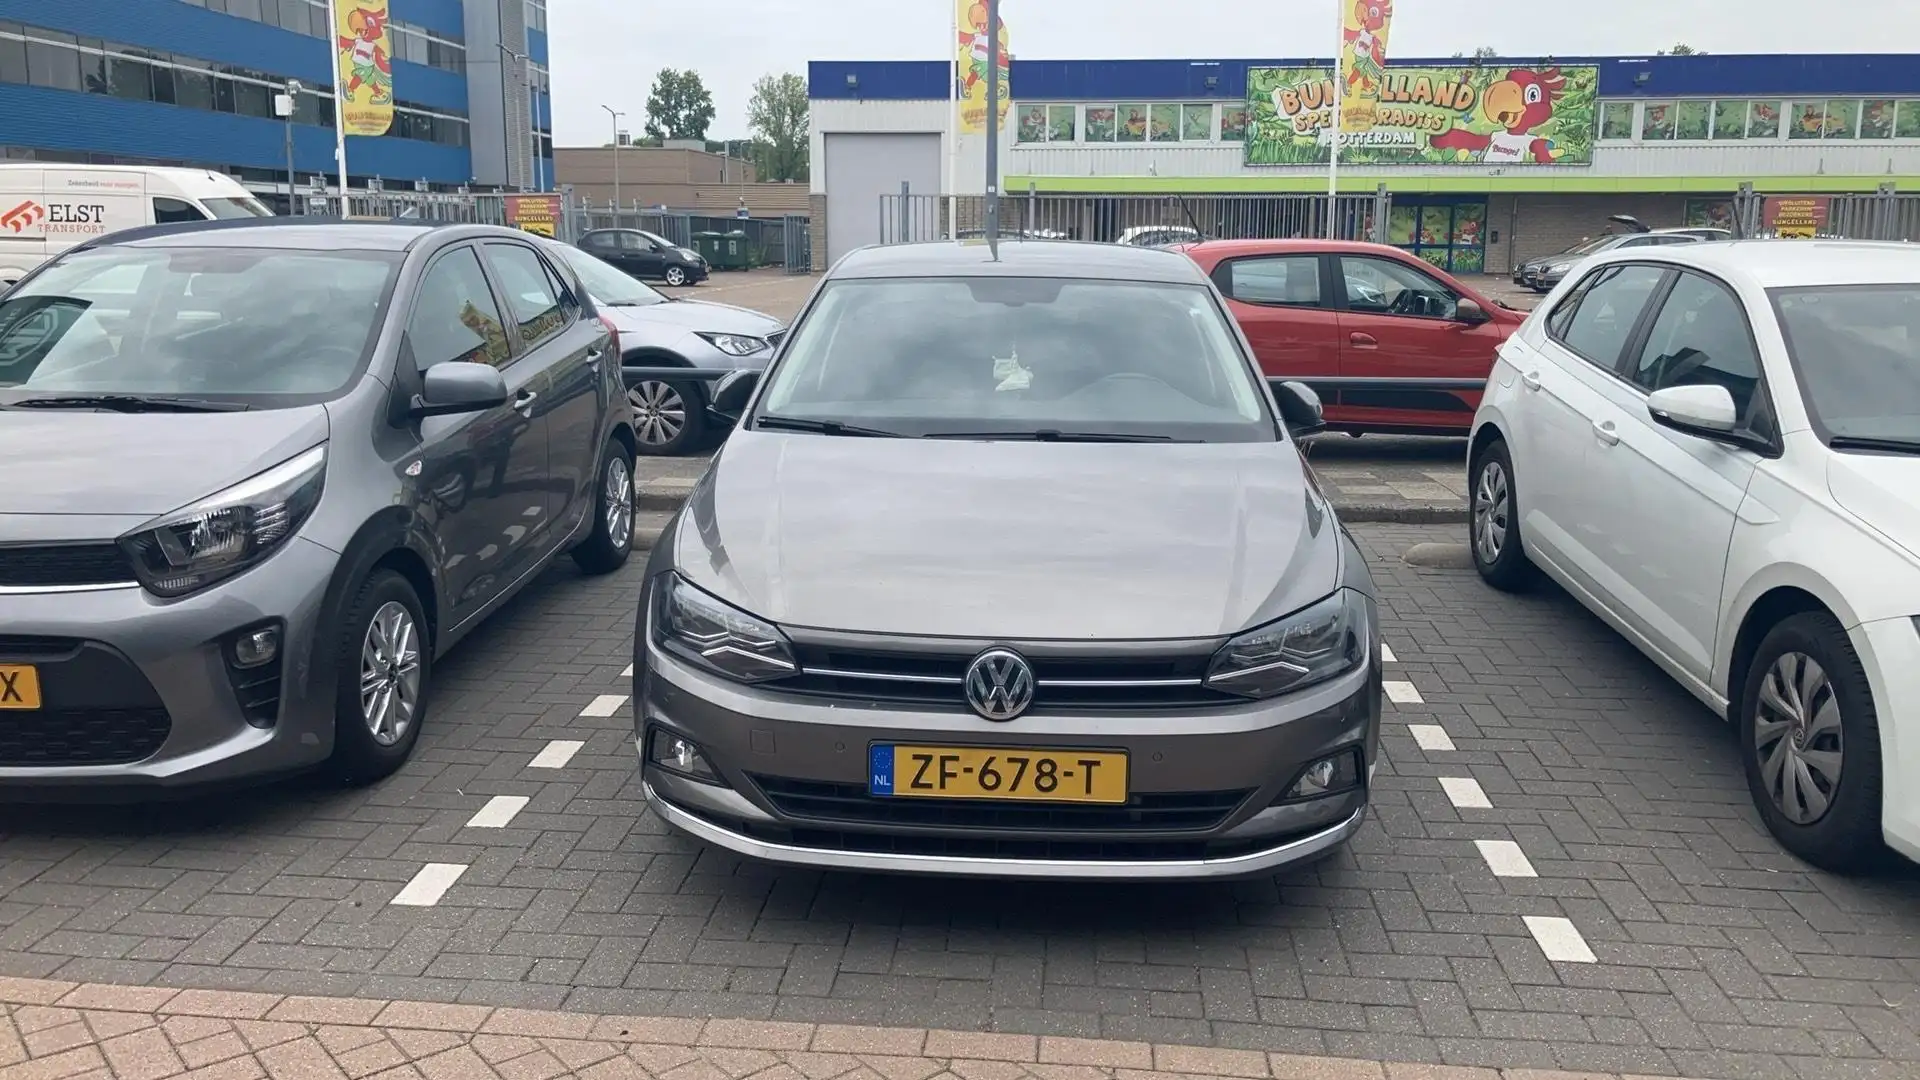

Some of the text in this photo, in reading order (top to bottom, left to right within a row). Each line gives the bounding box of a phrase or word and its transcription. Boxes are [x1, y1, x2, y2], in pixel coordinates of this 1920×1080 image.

[1279, 75, 1476, 115] BUNLLAND
[48, 204, 105, 223] ELST
[37, 223, 106, 234] TRANSPORT
[873, 774, 892, 787] NL
[910, 753, 1101, 795] ZF-678-T
